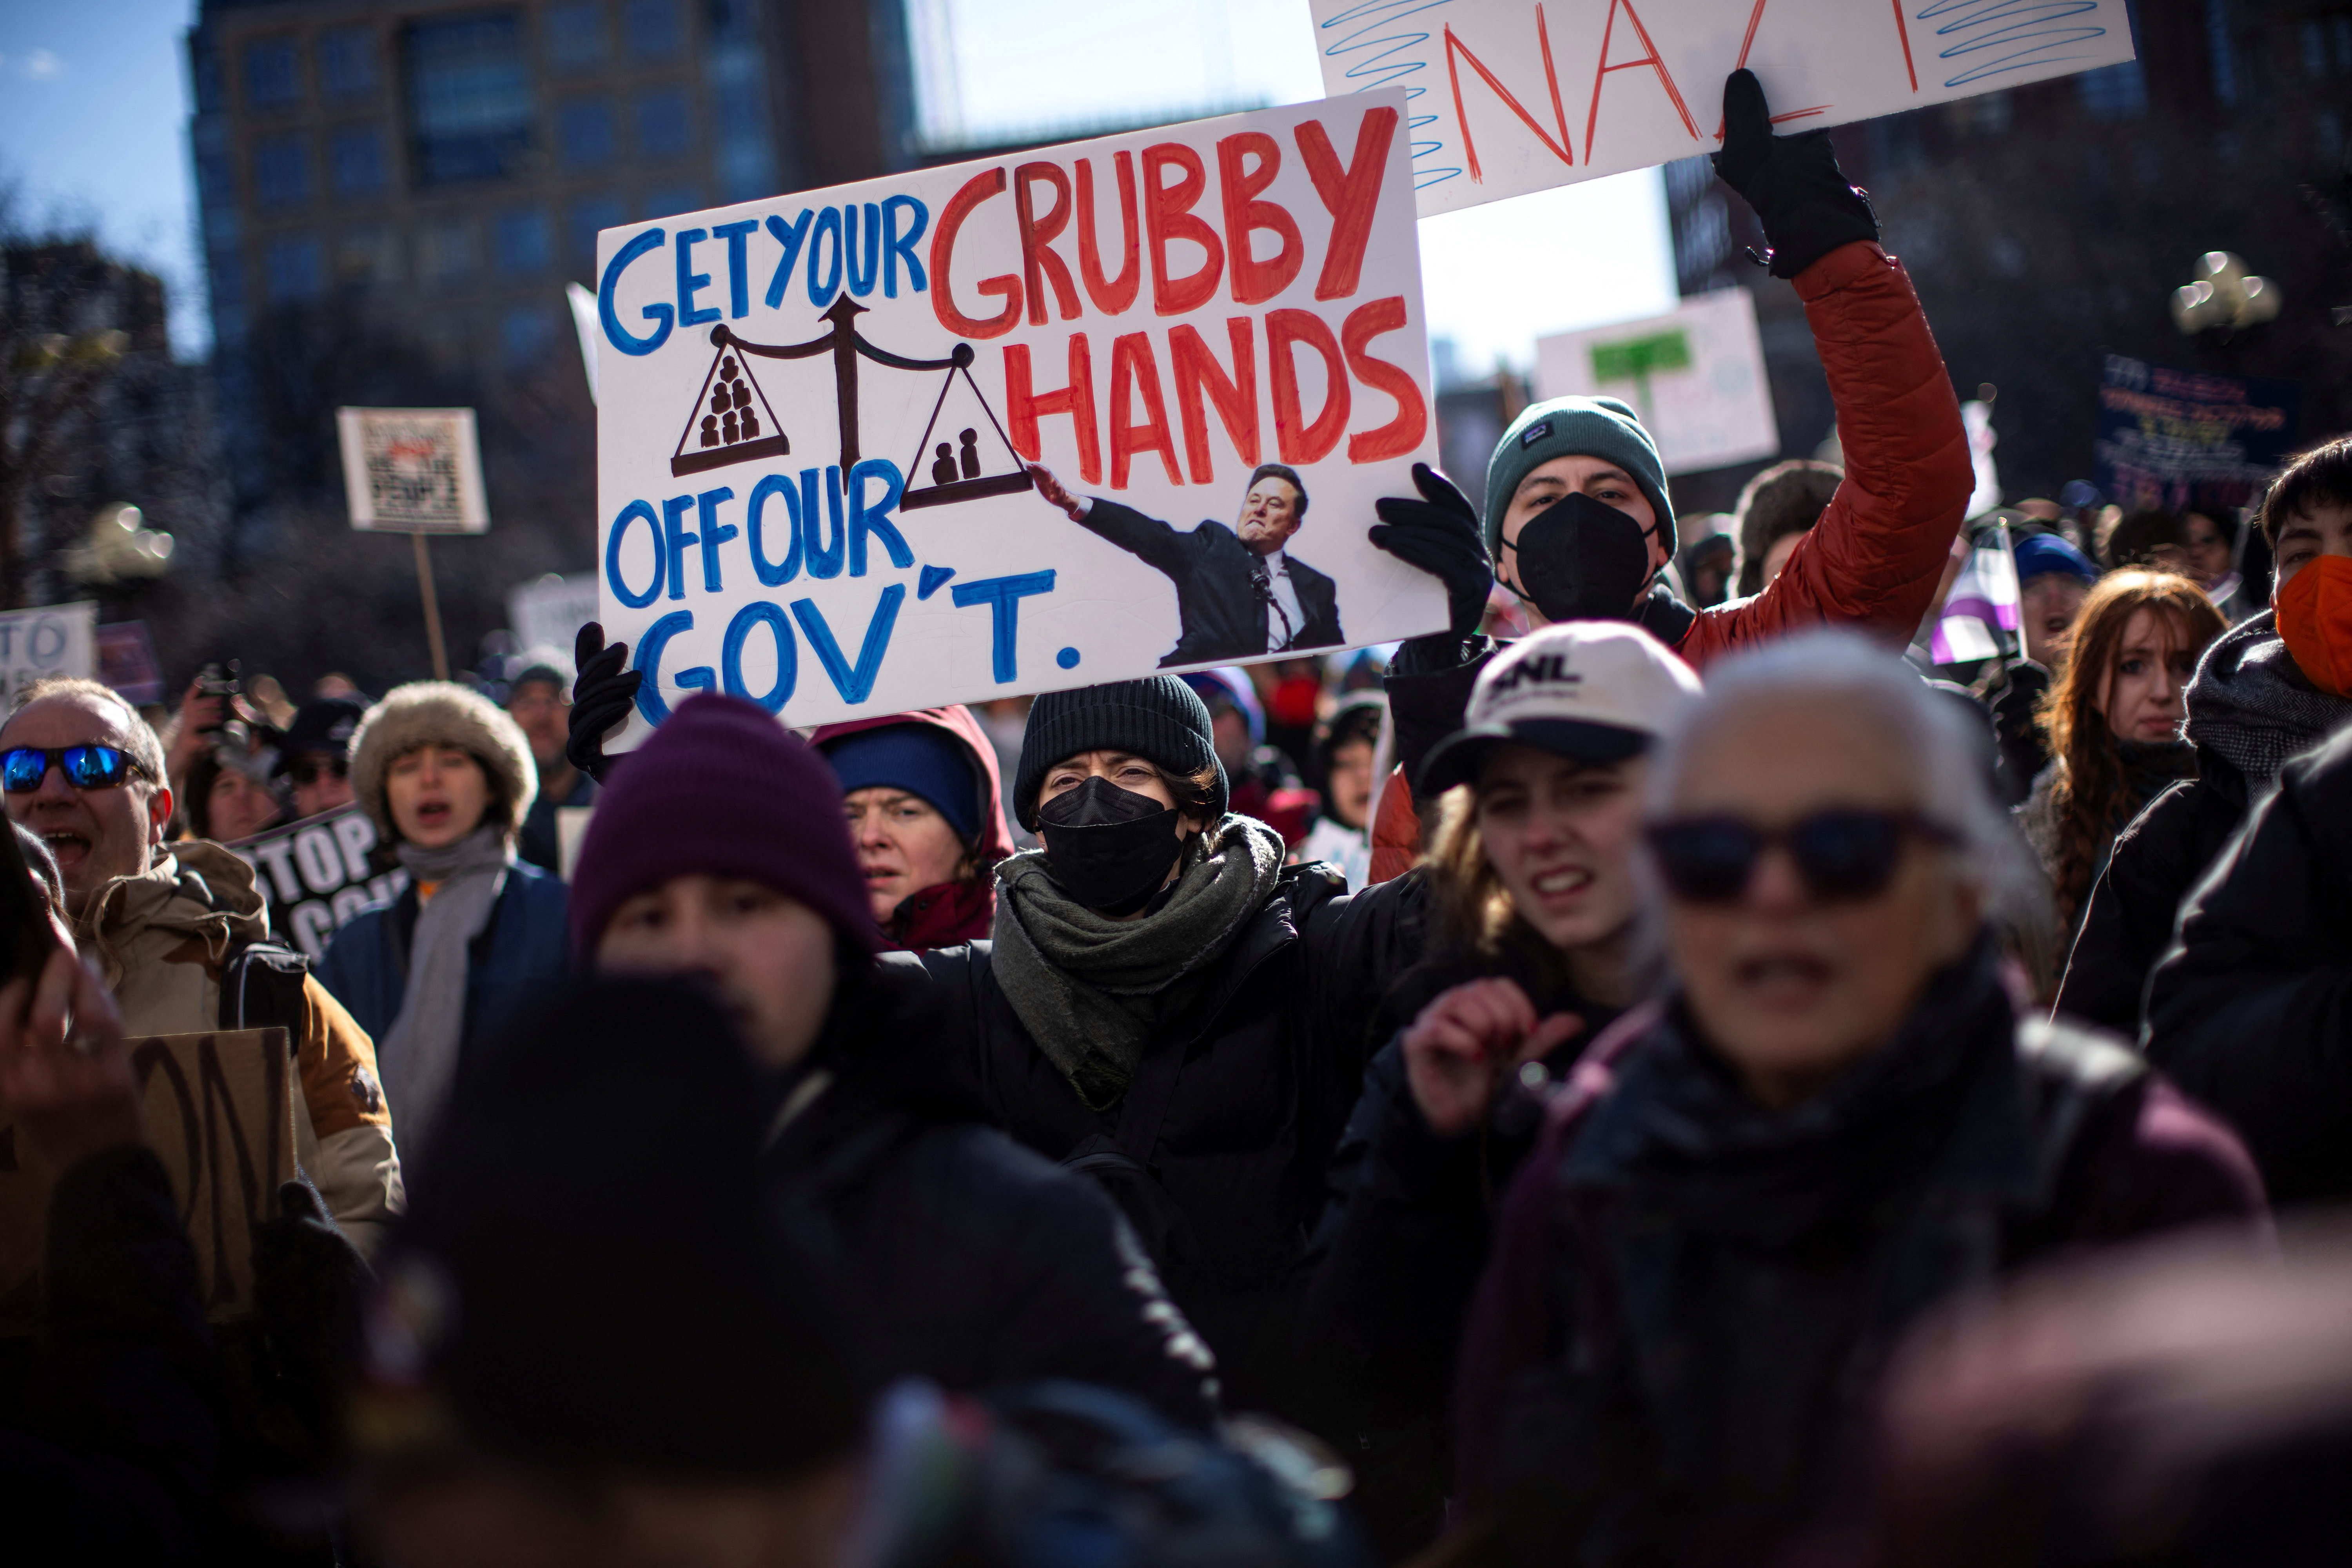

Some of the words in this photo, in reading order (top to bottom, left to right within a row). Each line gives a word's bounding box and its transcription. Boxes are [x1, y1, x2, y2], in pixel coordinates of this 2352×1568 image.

[598, 219, 759, 356] GET
[764, 194, 929, 310] YOUR
[929, 106, 1399, 339] GRUBBY
[1002, 294, 1428, 490] HANDS
[606, 486, 739, 609] OFF
[747, 459, 915, 588] OUR
[633, 564, 1081, 728] GOV'T.
[240, 810, 377, 908] TOP
